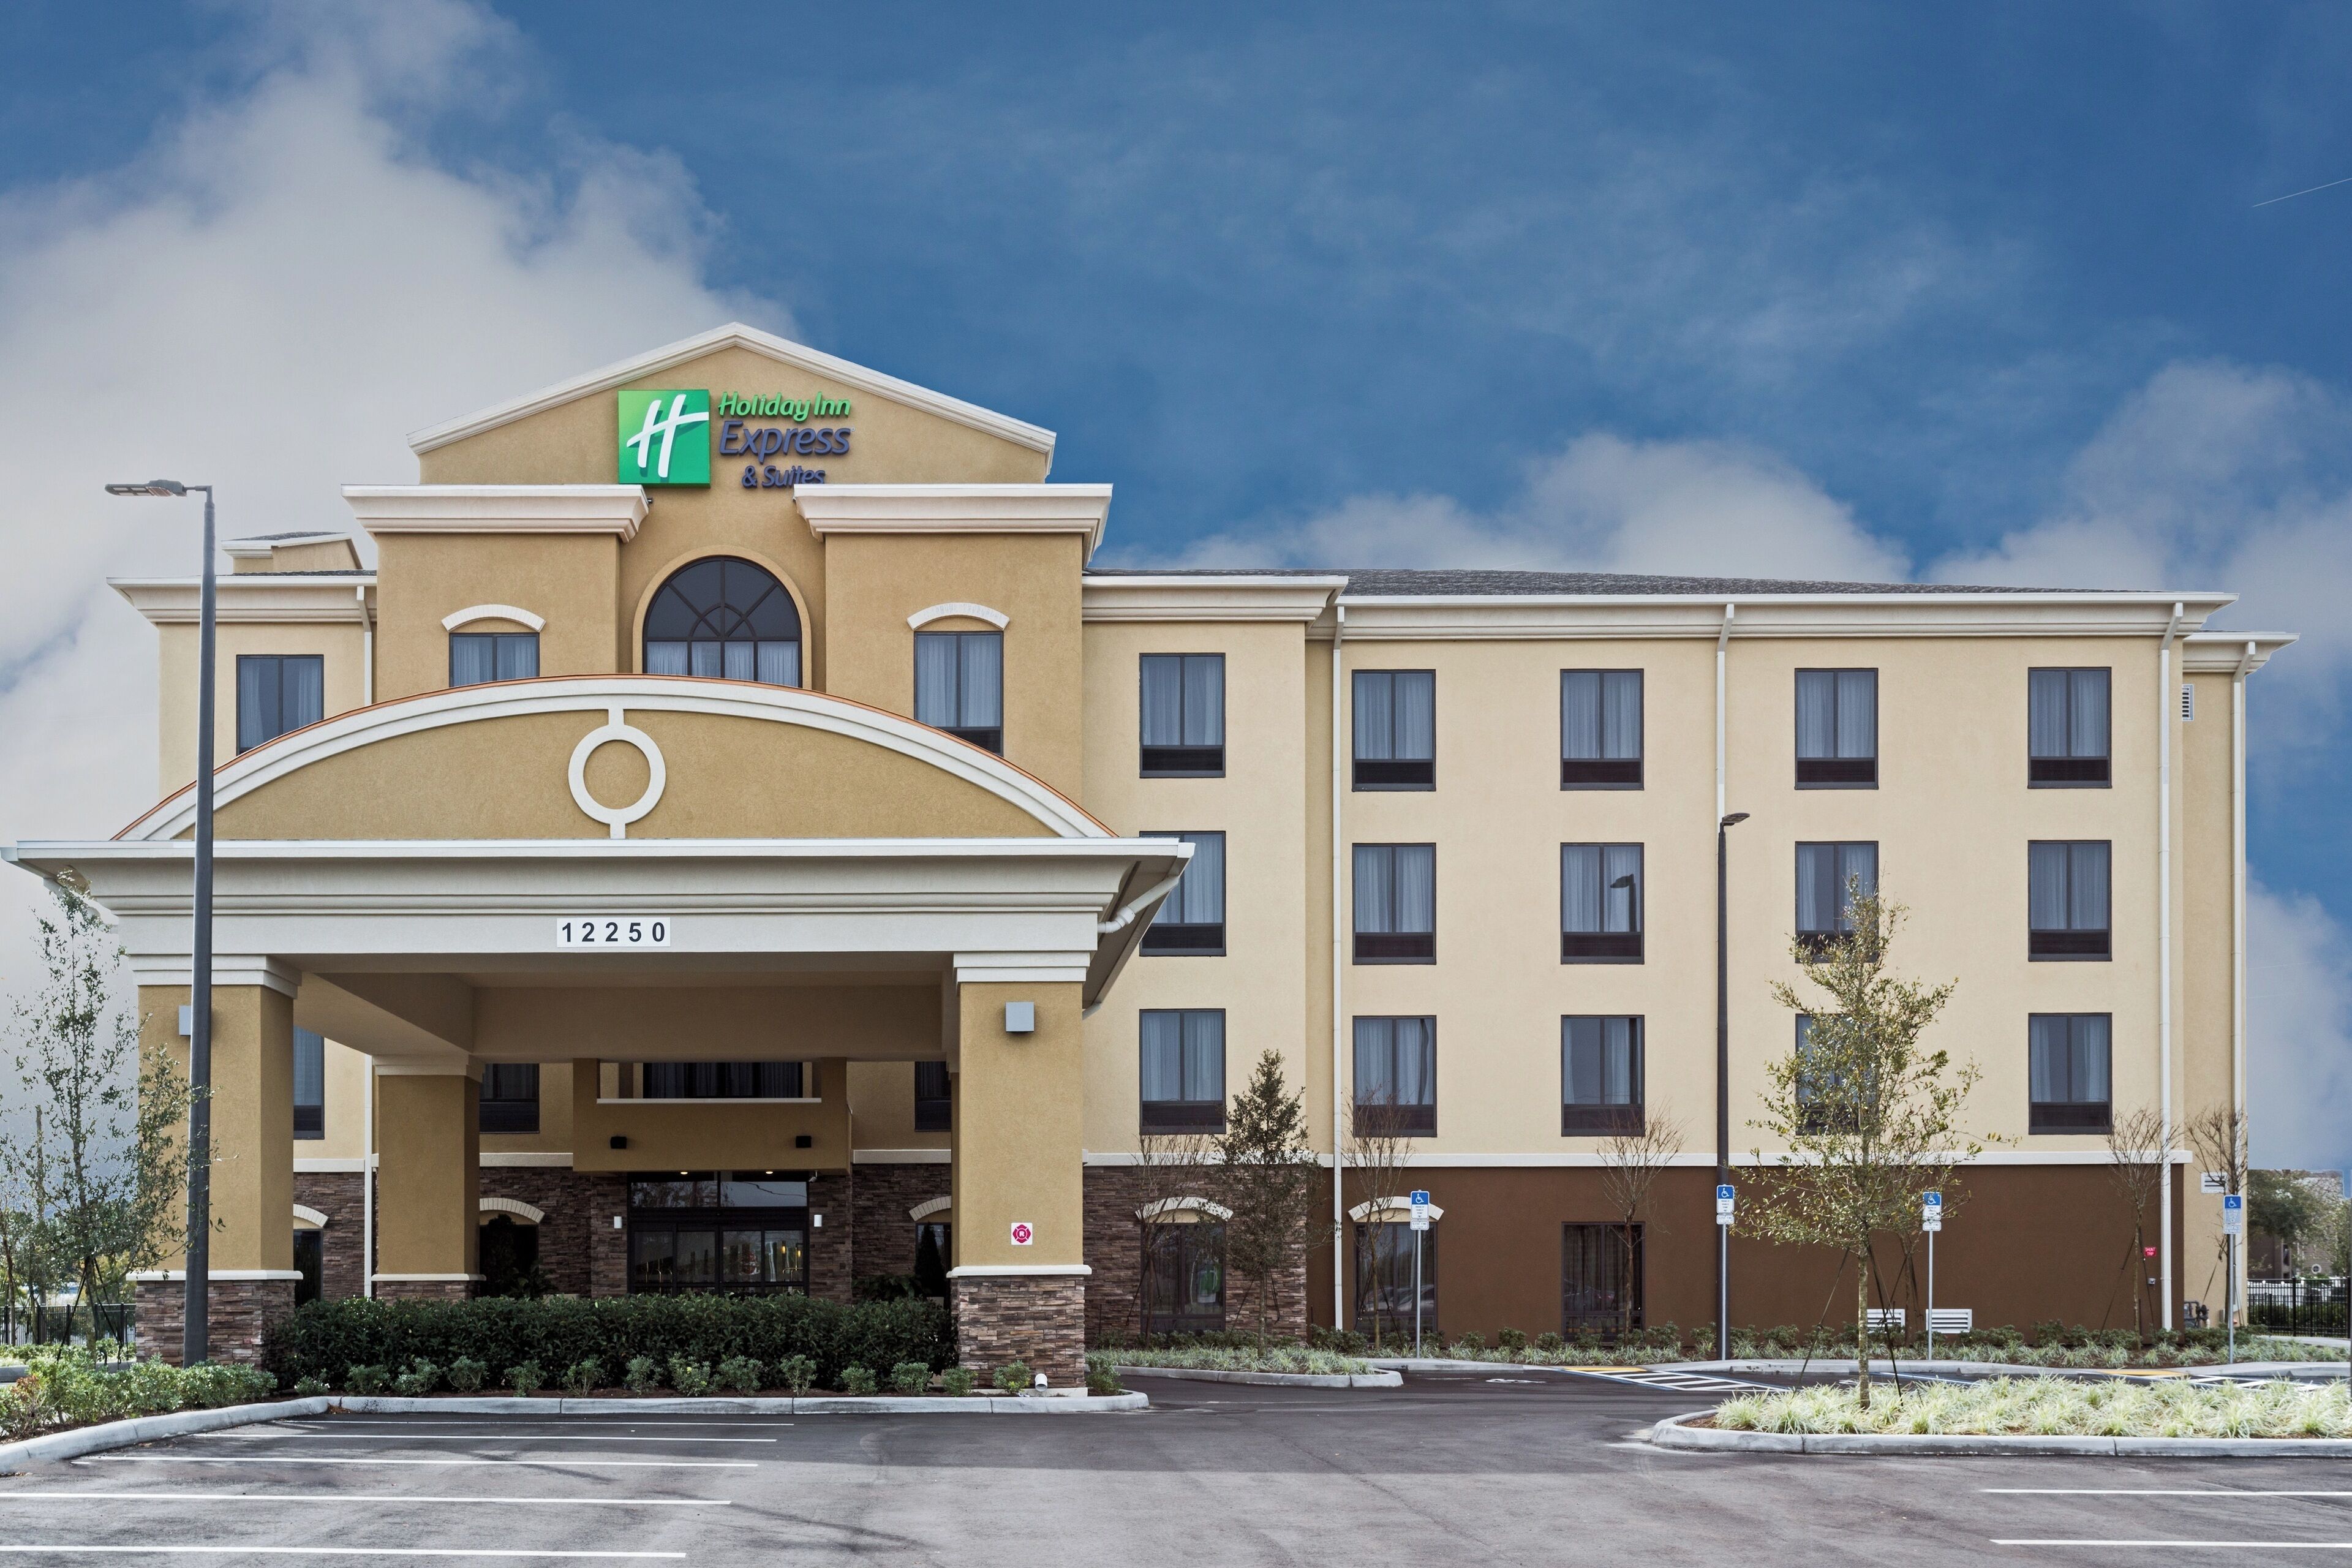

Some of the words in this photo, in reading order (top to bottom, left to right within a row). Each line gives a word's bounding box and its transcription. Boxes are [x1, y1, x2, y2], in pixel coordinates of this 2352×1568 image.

[718, 391, 811, 421] Holiday
[813, 391, 851, 416] Inn
[720, 420, 851, 464] Express
[741, 466, 757, 488] &
[761, 466, 826, 488] Suites
[562, 922, 665, 943] 12250
